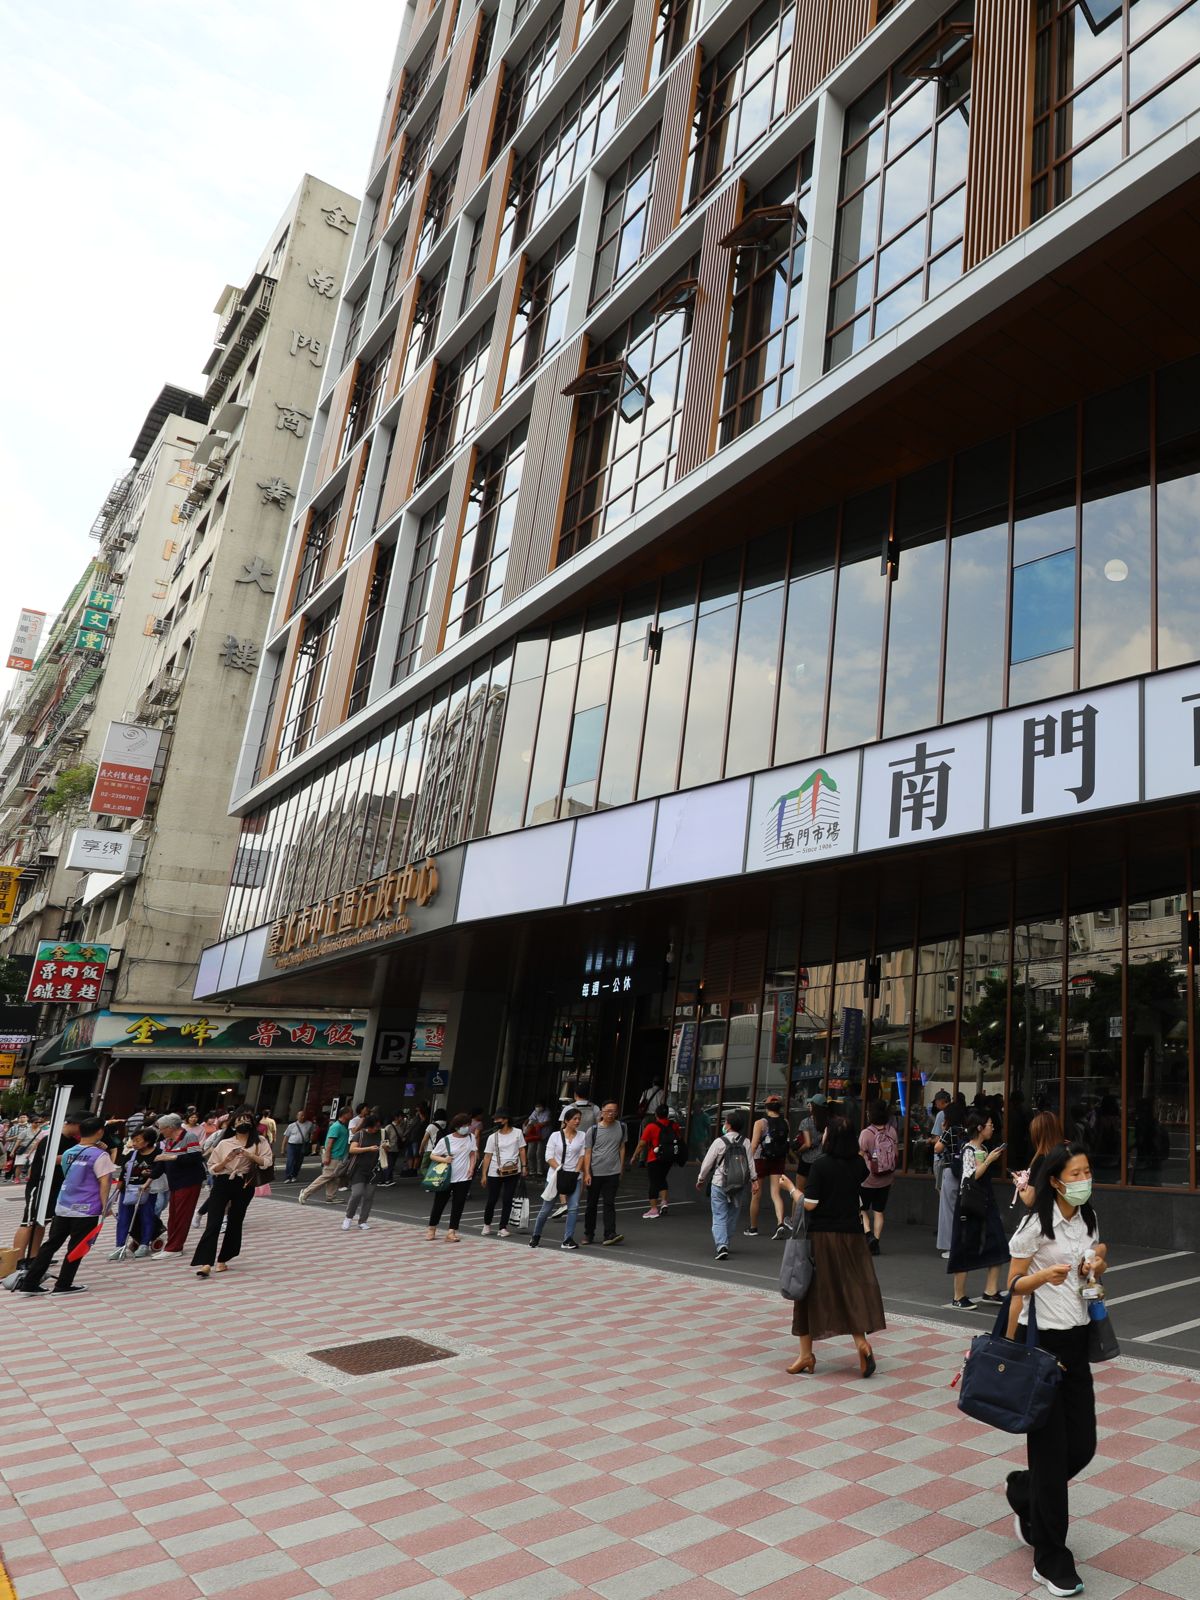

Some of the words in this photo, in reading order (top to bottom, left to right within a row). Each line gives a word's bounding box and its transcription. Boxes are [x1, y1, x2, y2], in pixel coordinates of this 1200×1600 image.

[219, 205, 357, 675] 金南門商業大樓
[781, 821, 841, 850] 南門市場
[81, 839, 123, 856] 享練
[819, 844, 833, 852] 1906
[266, 857, 440, 958] 臺北市中正區行政中心
[376, 921, 396, 940] Taipei
[50, 945, 97, 960] 金峰
[40, 963, 101, 981] 魯肉飯
[581, 975, 632, 998] 每週一公休
[126, 1015, 219, 1047] 金峰
[249, 1018, 356, 1048] 魯肉飯
[380, 1034, 405, 1060] P
